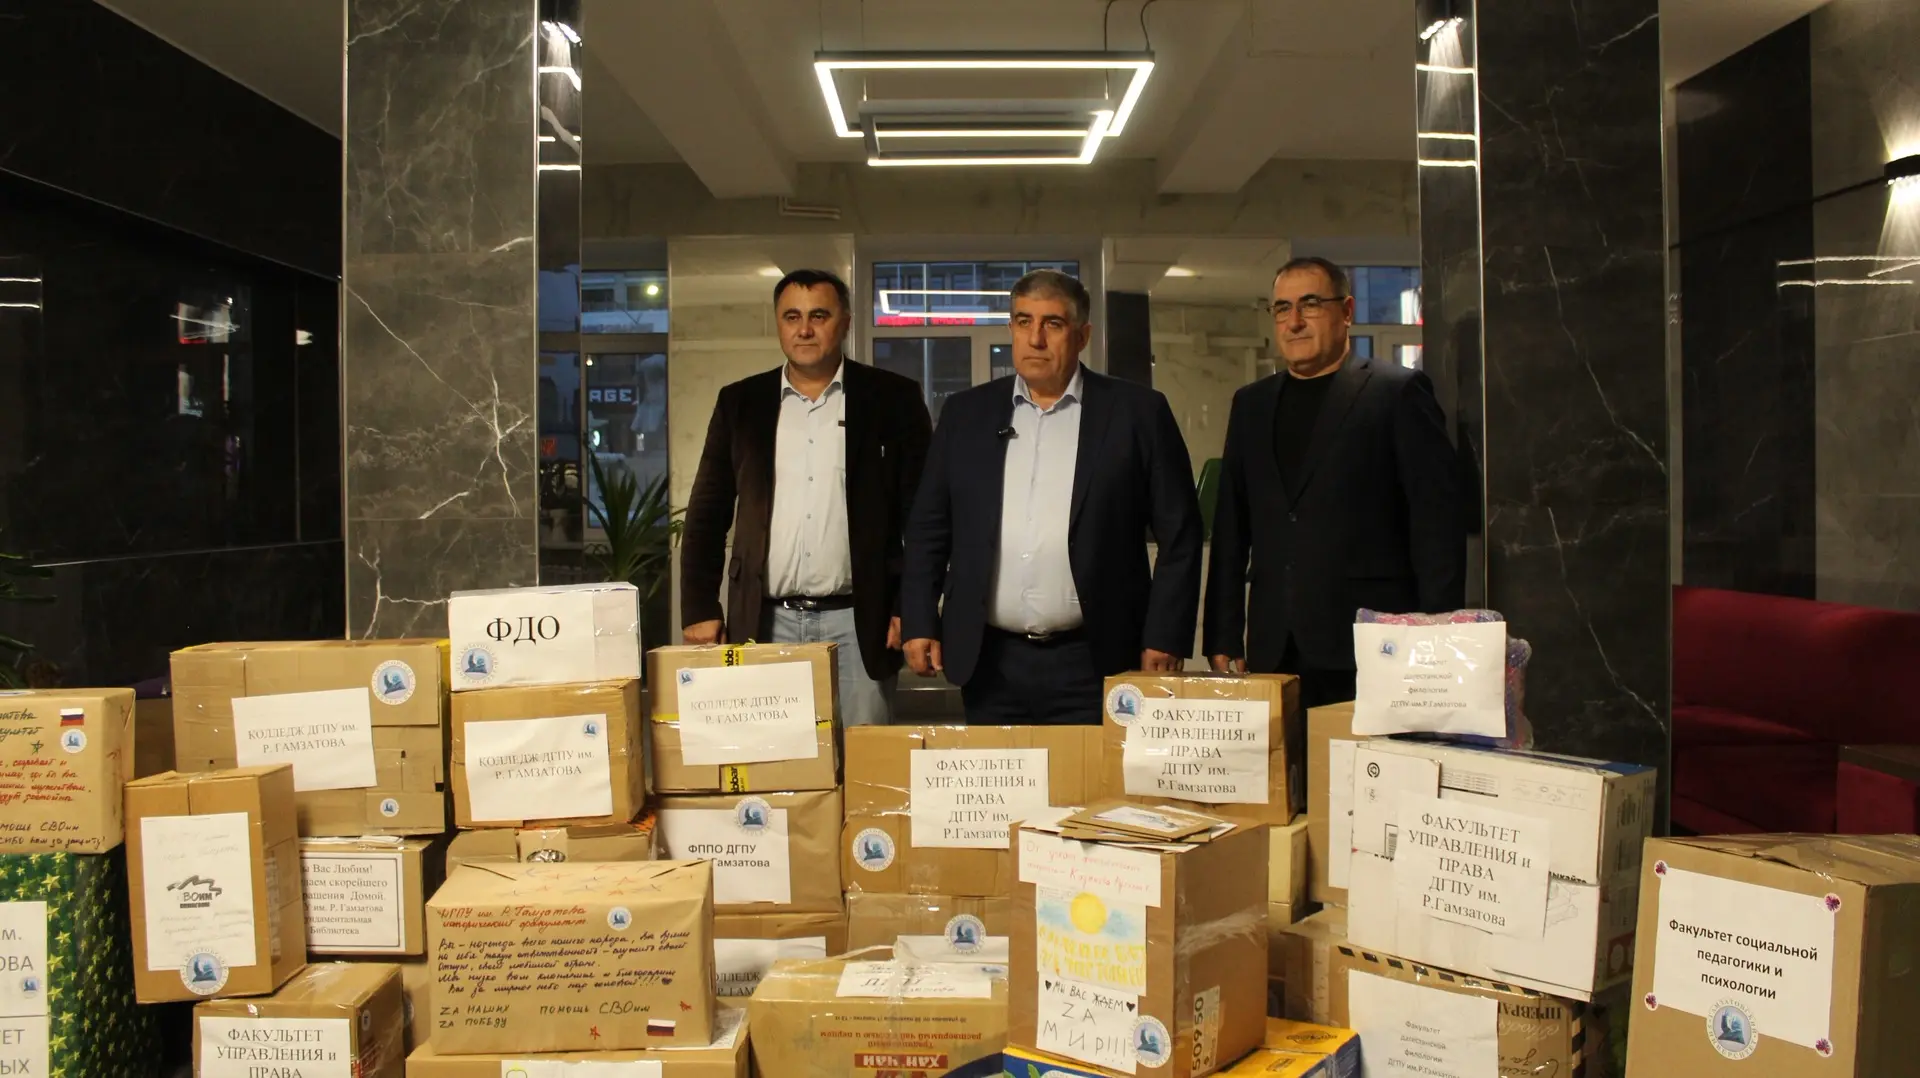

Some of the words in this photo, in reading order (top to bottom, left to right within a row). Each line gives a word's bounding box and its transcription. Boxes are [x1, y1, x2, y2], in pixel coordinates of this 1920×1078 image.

[486, 615, 560, 646] ФДО
[690, 698, 748, 711] КОЛЛЕДЖ
[750, 696, 781, 707] ДГПУ
[784, 696, 801, 704] им.
[717, 710, 789, 724] ГАМЗАТОВА
[1152, 709, 1243, 723] ФАКУЛЬТЕТ
[248, 726, 304, 740] КОЛЛЕДЖ
[307, 724, 339, 736] ДГПУ
[342, 724, 359, 733] им.
[1141, 726, 1243, 741] УПРАВЛЕНИЯ
[1247, 731, 1256, 741] и
[263, 744, 273, 754] Р.
[275, 738, 346, 753] ГАМЗАТОВА
[1170, 745, 1222, 758] ПРАВА
[479, 755, 539, 768] КОЛЛЕДЖ
[542, 751, 575, 763] ДГПУ
[578, 751, 595, 760] им.
[936, 759, 1025, 771] ФАКУЛЬТЕТ
[495, 771, 505, 780] Р.
[507, 766, 582, 779] ГАМЗАТОВА
[1162, 763, 1204, 776] ДГПУ
[1208, 766, 1229, 776] им.
[925, 776, 1024, 789] УПРАВЛЕНИЯ
[1028, 778, 1036, 787] и
[1157, 779, 1237, 794] Р.Гамзатова
[955, 794, 1005, 805] ПРАВА
[948, 811, 988, 824] ДГПУ
[992, 812, 1013, 822] им.
[1421, 812, 1521, 843] ФАКУЛЬТЕТ
[688, 844, 723, 854] ФППО
[726, 844, 757, 855] ДГПУ
[1408, 829, 1518, 866] УПРАВЛЕНИЯ
[1522, 857, 1531, 869] и
[313, 864, 331, 873] Вас
[333, 864, 373, 874] Любим!
[1439, 856, 1495, 882] ПРАВА
[329, 878, 388, 888] скорейшего
[1429, 876, 1474, 897] ДГПУ
[1478, 889, 1501, 904] им.
[340, 904, 384, 913] Гамзатова
[1422, 894, 1506, 927] Р.Гамзатова
[0, 929, 22, 941] М.
[309, 926, 360, 935] Библиотека
[1669, 918, 1733, 944] Факультет
[1736, 934, 1818, 961] социальной
[1696, 949, 1771, 975] педагогики
[1774, 966, 1783, 978] и
[715, 972, 760, 982] ЛЛЕДЖ
[1701, 972, 1776, 1000] психологии
[1405, 1020, 1441, 1035] Факультет
[0, 1028, 25, 1045] ЕТ
[228, 1029, 324, 1042] ФАКУЛЬТЕТ
[1400, 1035, 1446, 1050] дагестанской
[217, 1046, 323, 1061] УПРАВЛЕНИЯ
[328, 1051, 336, 1061] и
[1404, 1049, 1443, 1063] филологии
[863, 1055, 899, 1067] ЧАЙ
[906, 1055, 940, 1068] ХАН
[1388, 1058, 1405, 1068] ДГПУ
[249, 1066, 303, 1078] ПРАВА
